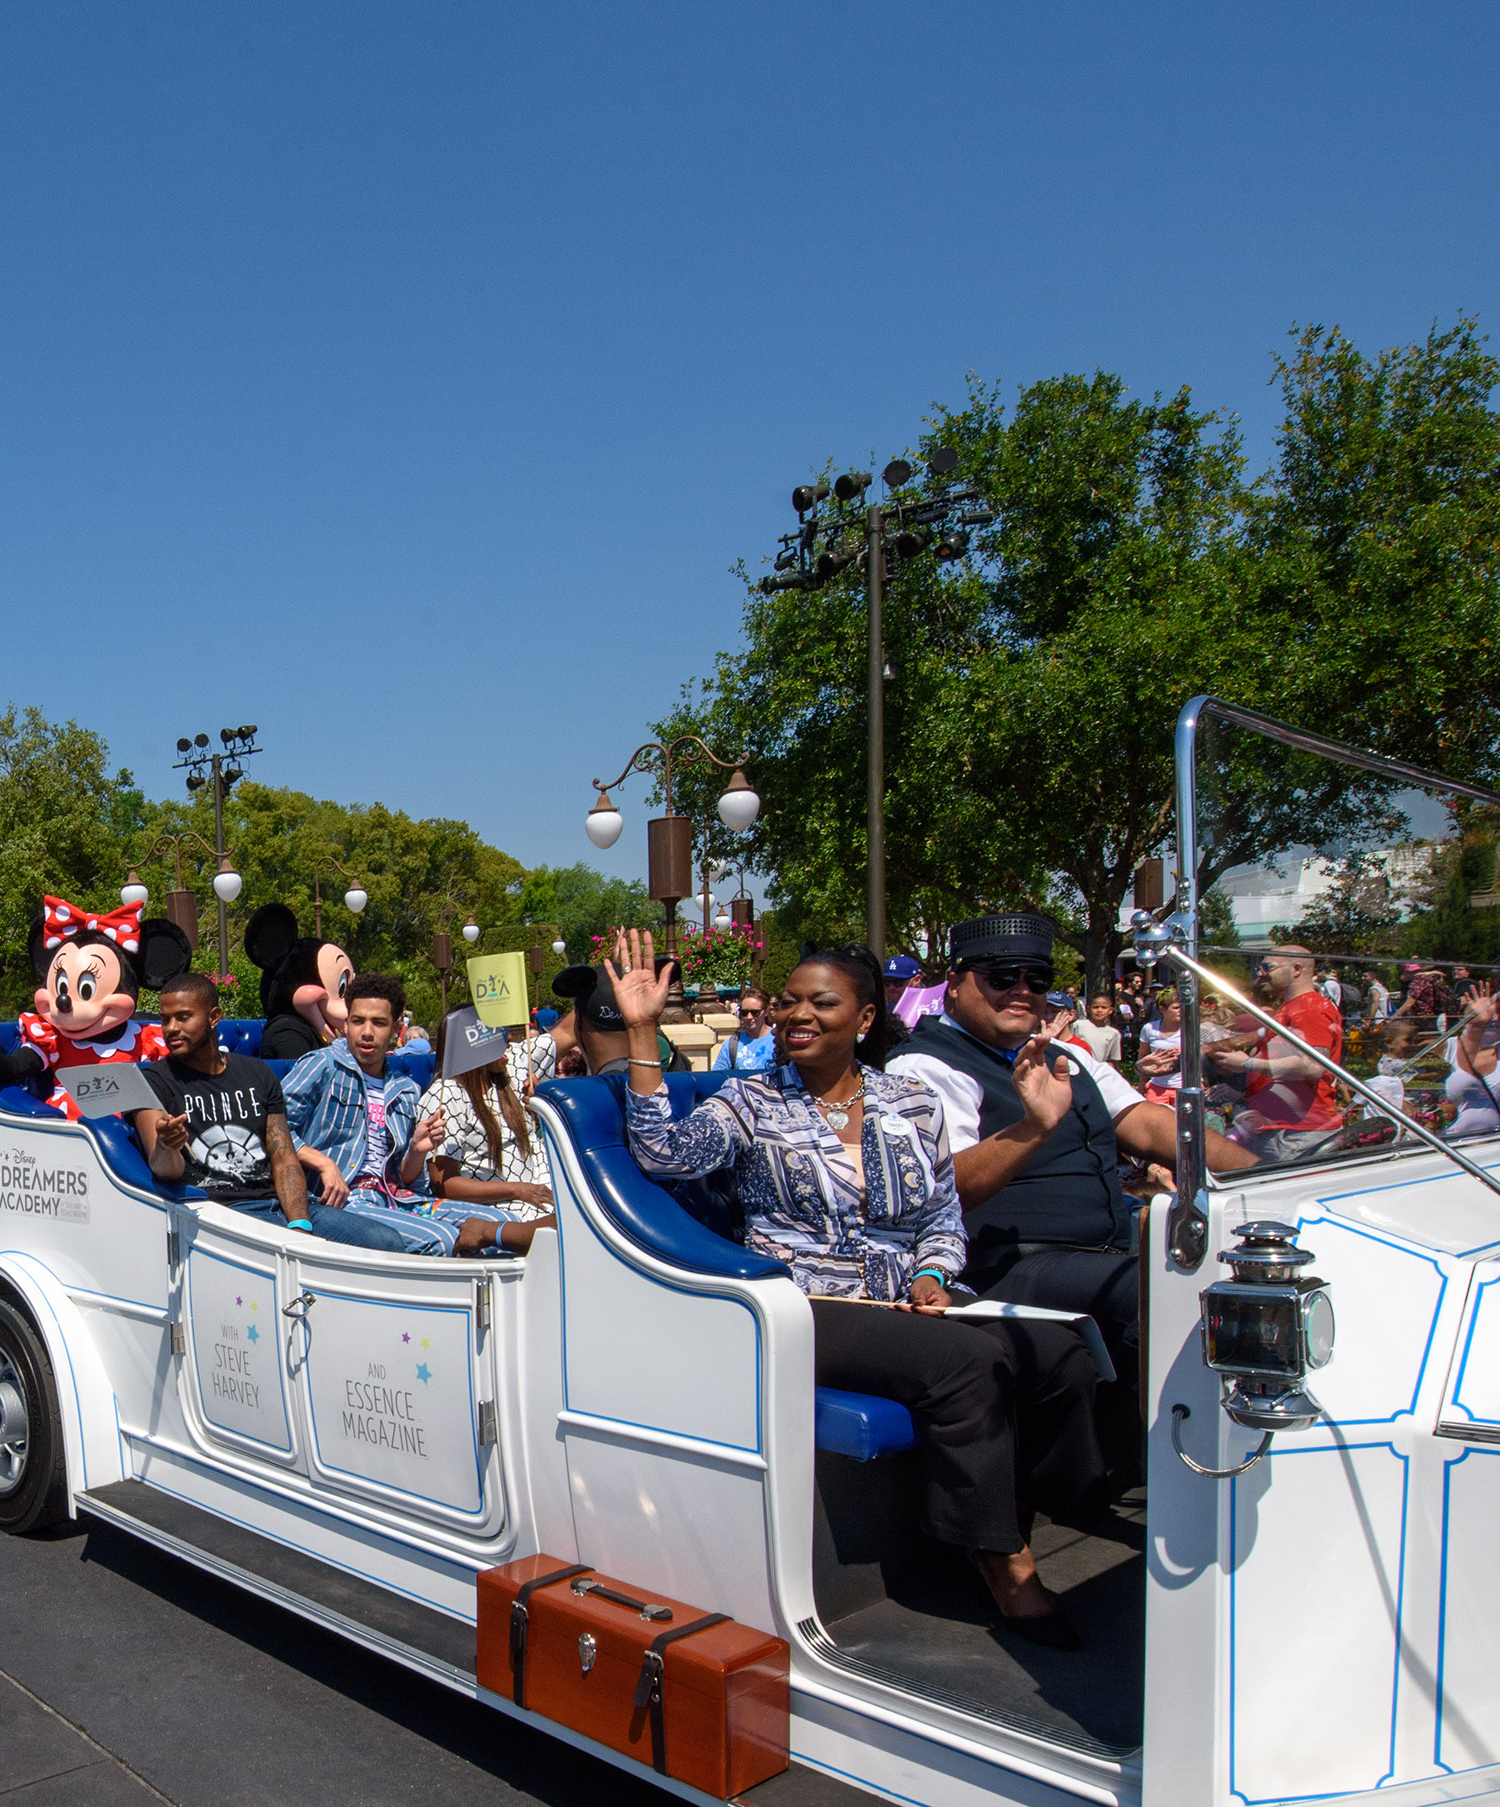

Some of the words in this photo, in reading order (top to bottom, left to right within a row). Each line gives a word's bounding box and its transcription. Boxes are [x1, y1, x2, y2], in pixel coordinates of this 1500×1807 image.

[184, 1087, 262, 1124] PRINCE
[1, 1165, 88, 1196] DREAMERS
[0, 1191, 60, 1216] ACADEMY
[221, 1324, 239, 1341] WITH
[214, 1343, 251, 1376] STEVE
[368, 1363, 386, 1380] AND
[212, 1372, 259, 1409] HARVEY
[346, 1380, 415, 1421] ESSENCE
[342, 1410, 427, 1457] MAGAZINE
